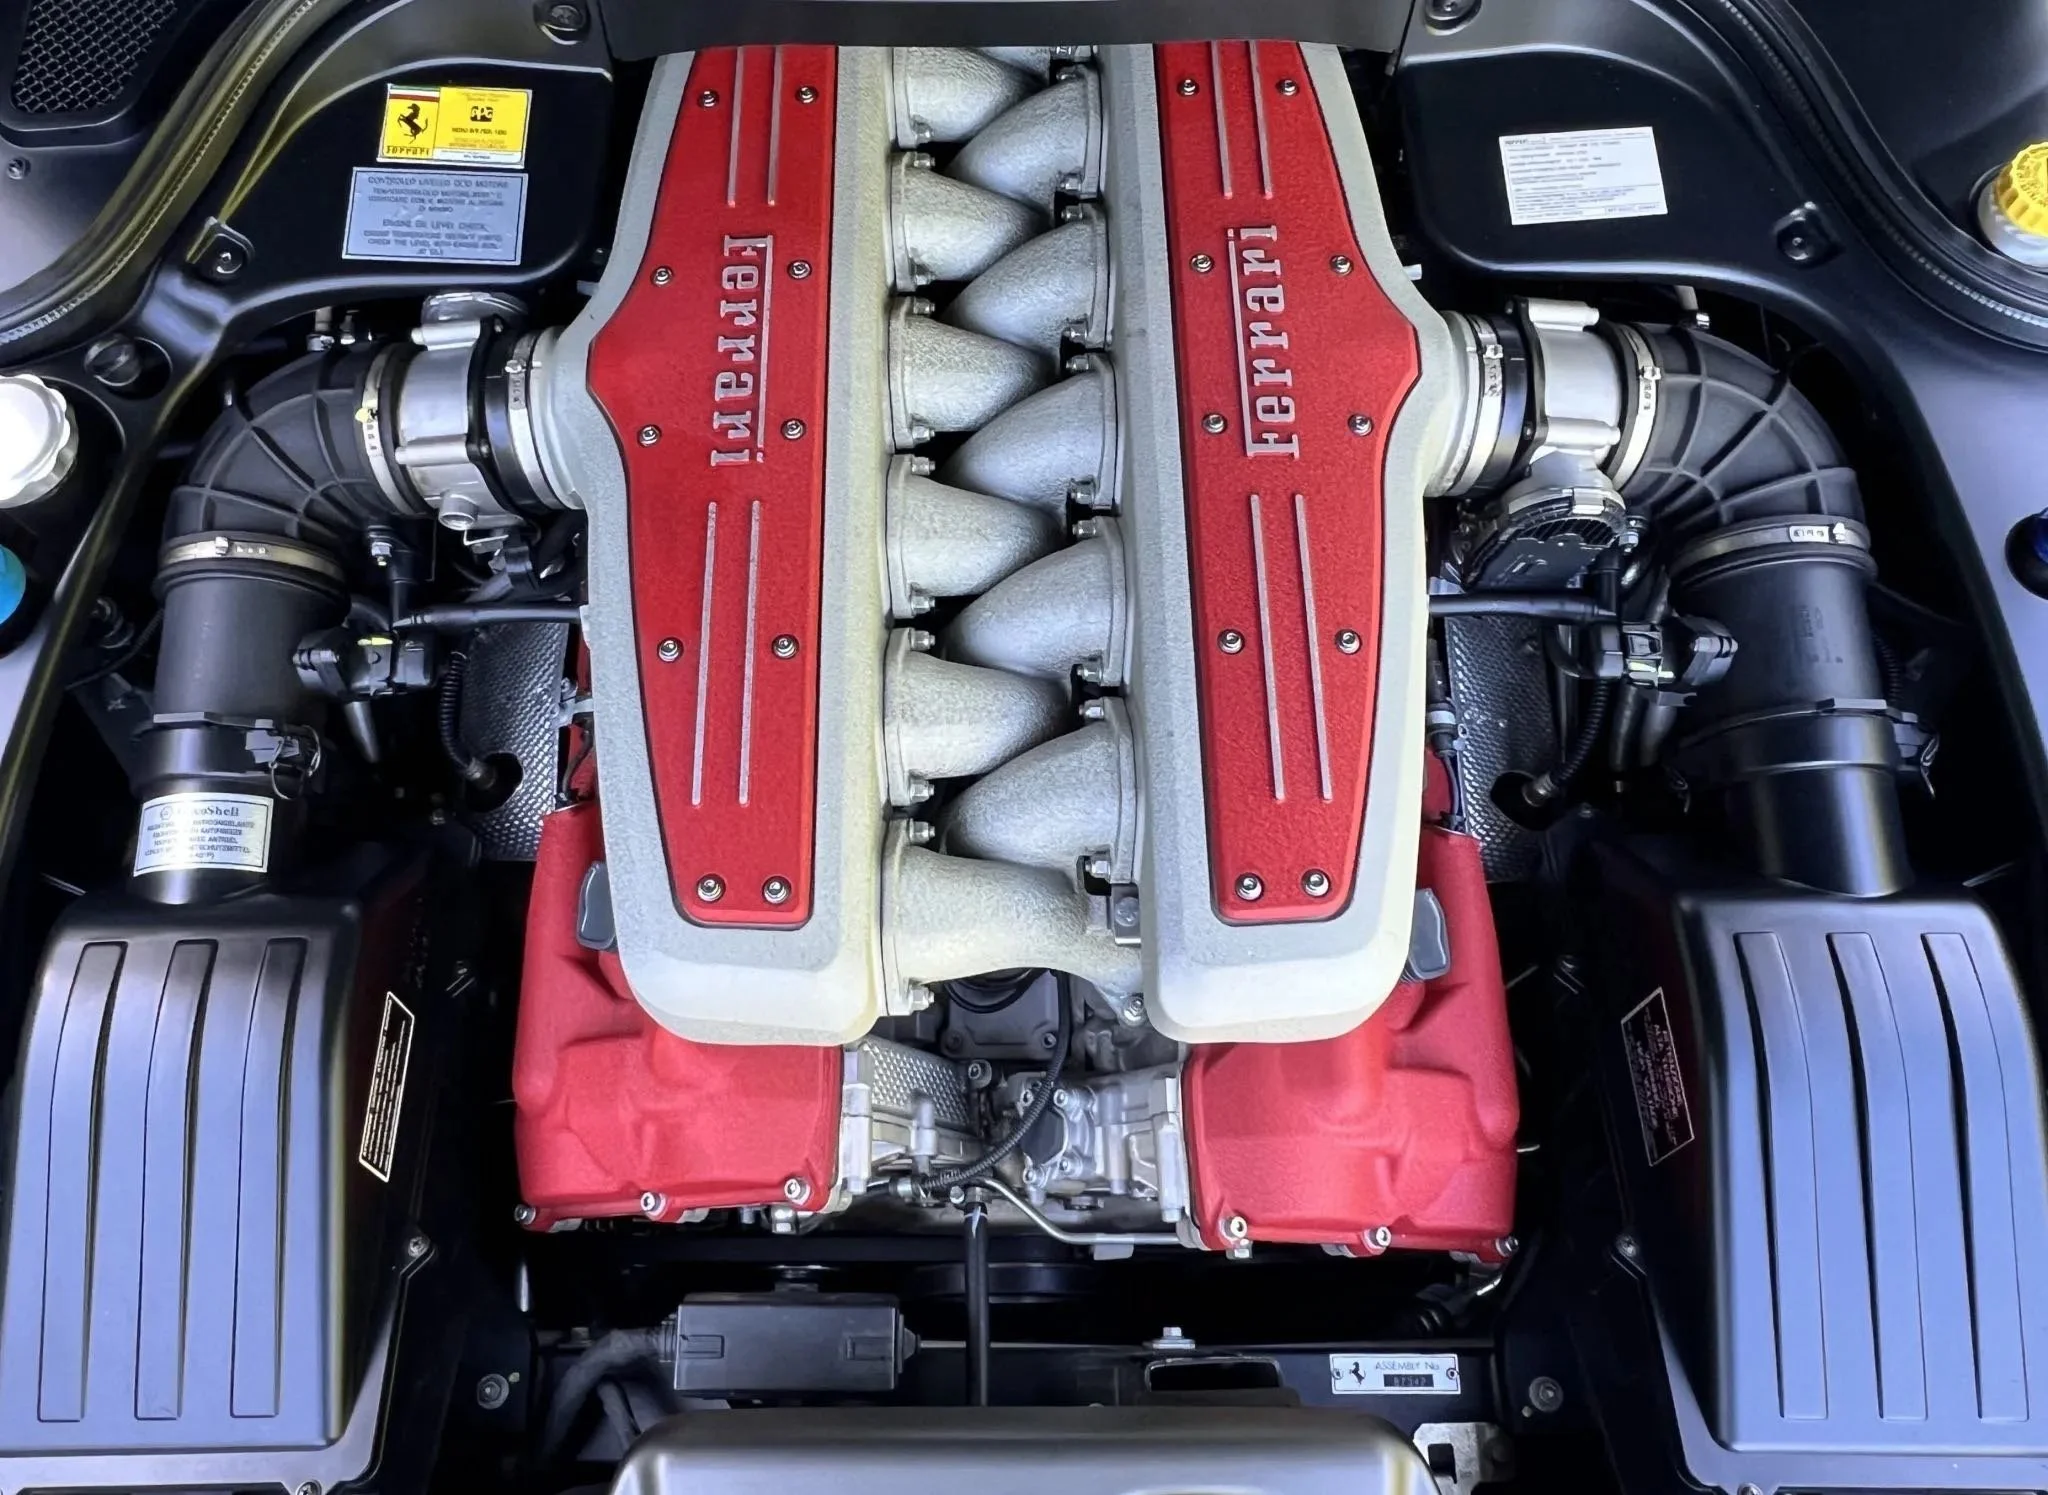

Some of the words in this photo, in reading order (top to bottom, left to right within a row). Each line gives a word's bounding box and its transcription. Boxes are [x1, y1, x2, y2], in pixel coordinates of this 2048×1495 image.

[386, 145, 430, 156] Ferrari
[470, 105, 494, 122] PPG
[711, 234, 774, 467] Ferrari
[1227, 224, 1300, 460] Ferrari
